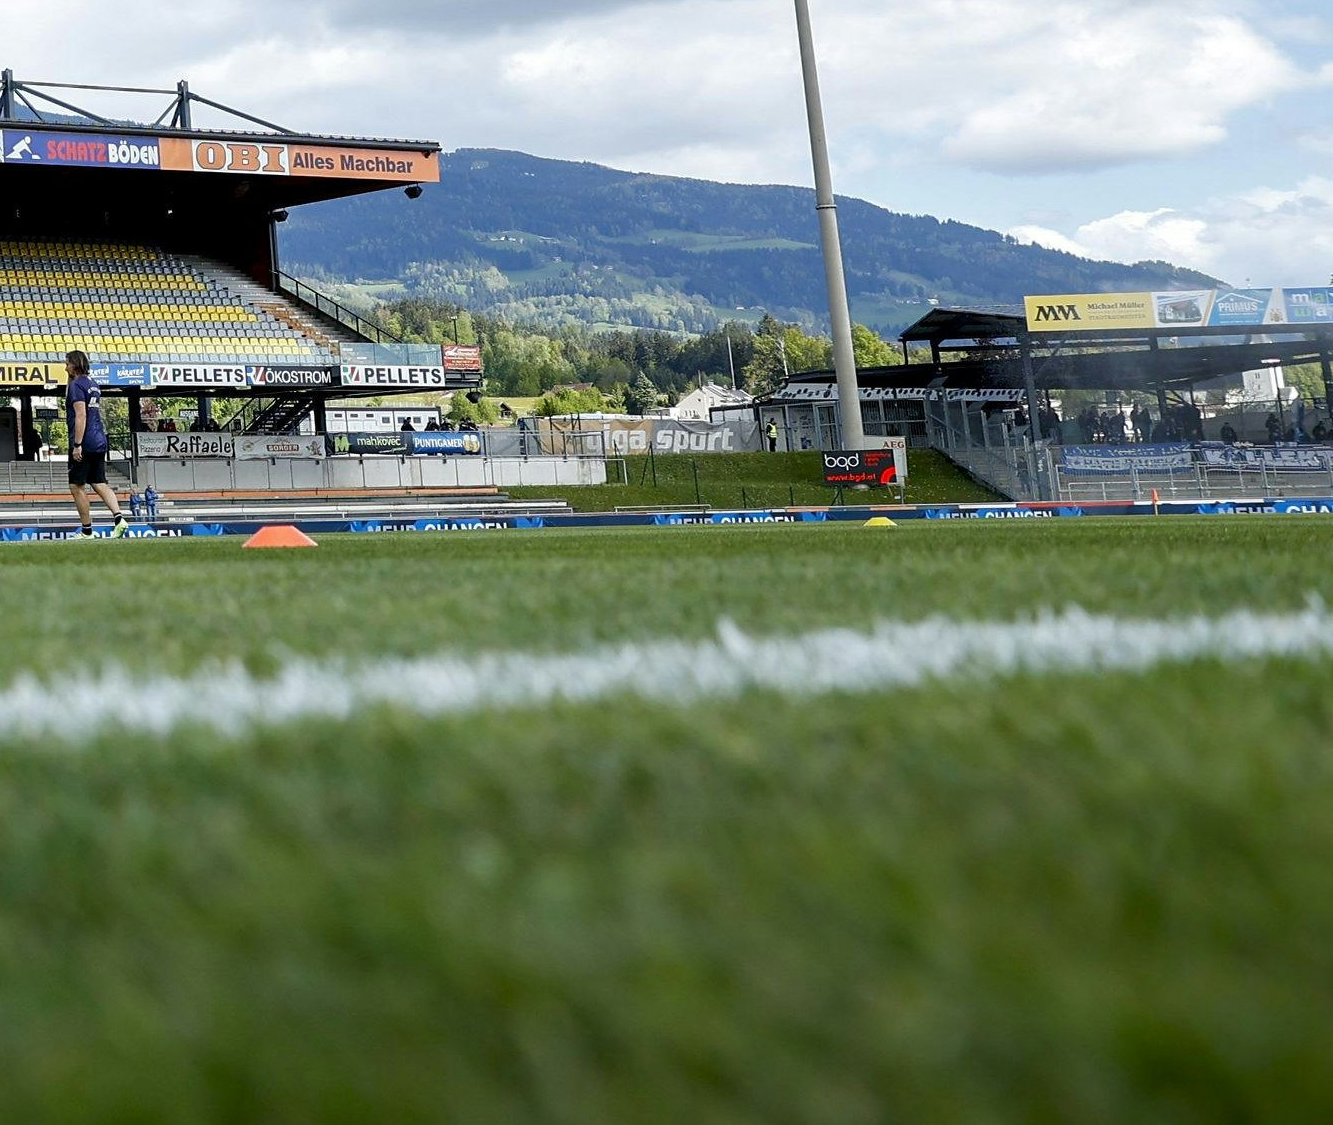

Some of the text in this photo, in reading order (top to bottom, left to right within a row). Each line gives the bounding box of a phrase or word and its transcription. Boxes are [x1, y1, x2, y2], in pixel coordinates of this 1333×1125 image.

[196, 142, 285, 172] OBI
[293, 152, 413, 174] Alles Machbar
[1219, 302, 1258, 312] PRIMUS
[172, 368, 244, 383] PELLETS
[265, 368, 332, 384] ÖKOSTROM
[365, 368, 442, 384] PELLETS
[167, 435, 231, 454] Raffaele
[357, 435, 401, 446] mahkovec
[414, 437, 463, 449] PUNTIGAMER
[656, 427, 734, 453] sport
